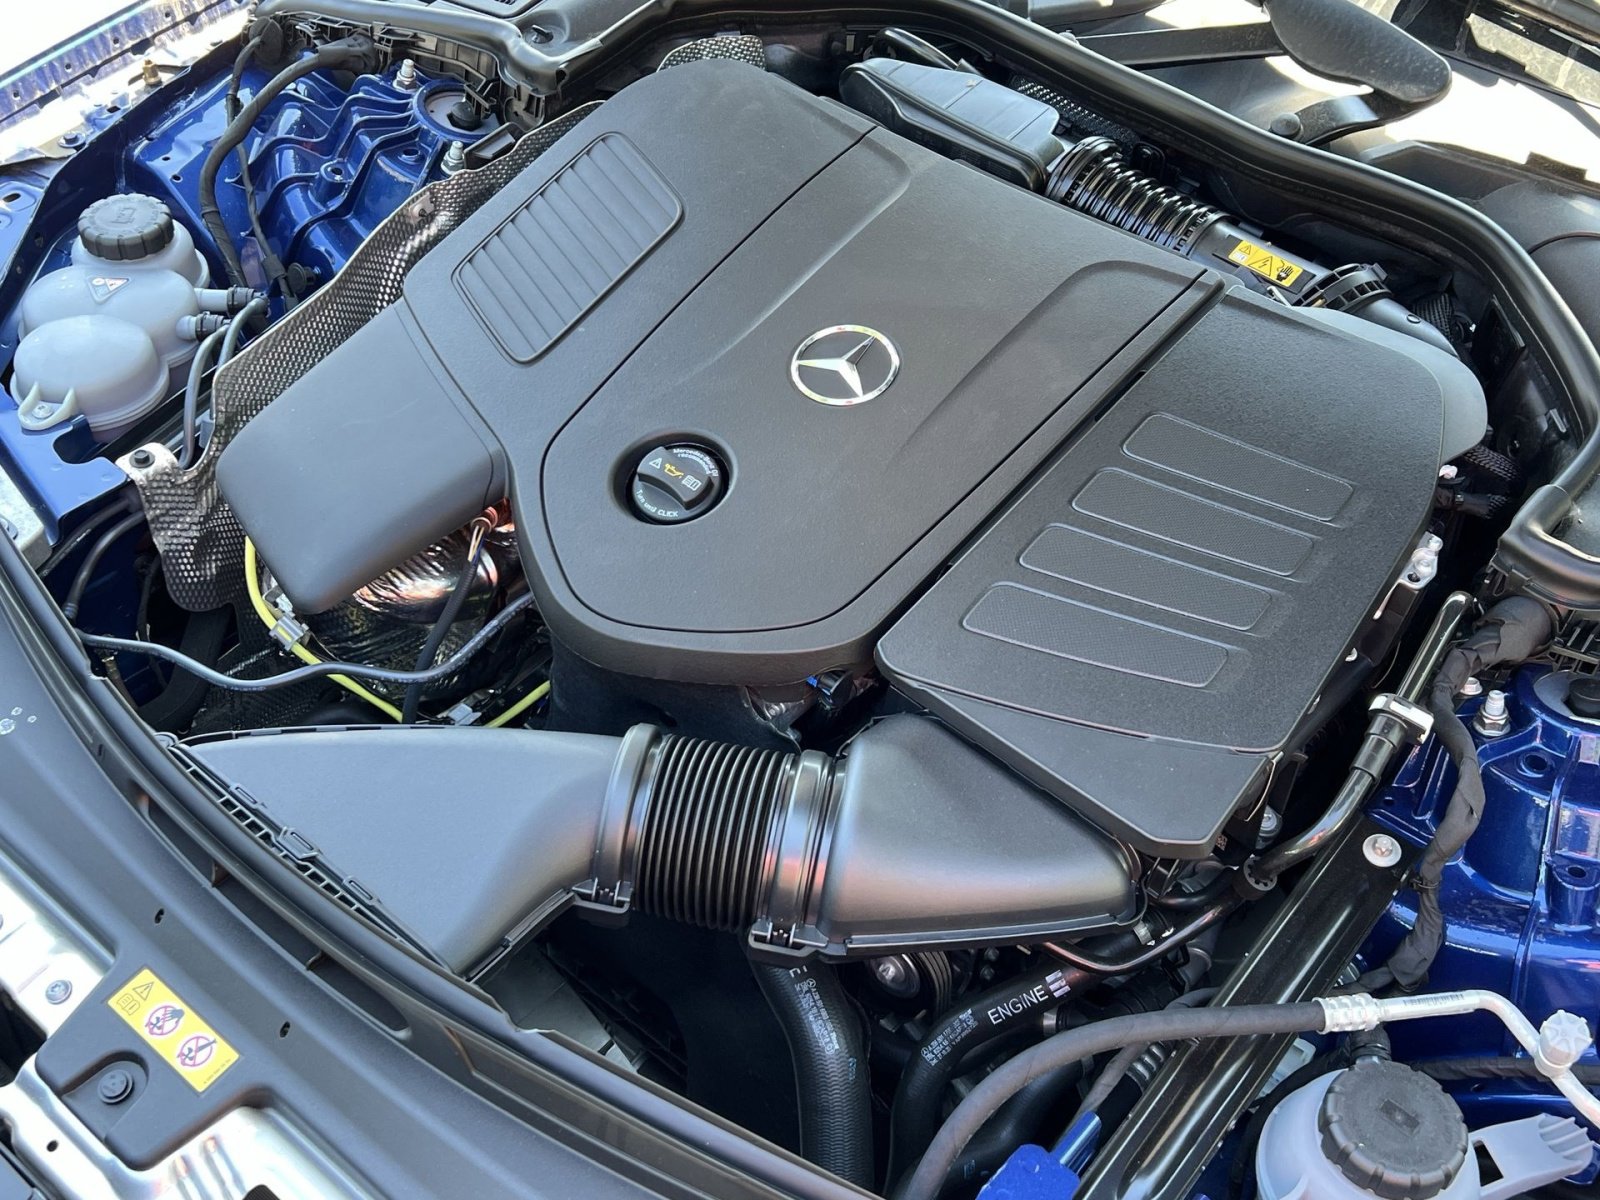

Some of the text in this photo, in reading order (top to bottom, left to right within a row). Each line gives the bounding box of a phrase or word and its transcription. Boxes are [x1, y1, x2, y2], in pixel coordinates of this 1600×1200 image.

[636, 489, 679, 517] Turn until CLICK
[987, 984, 1049, 1025] ENGINE
